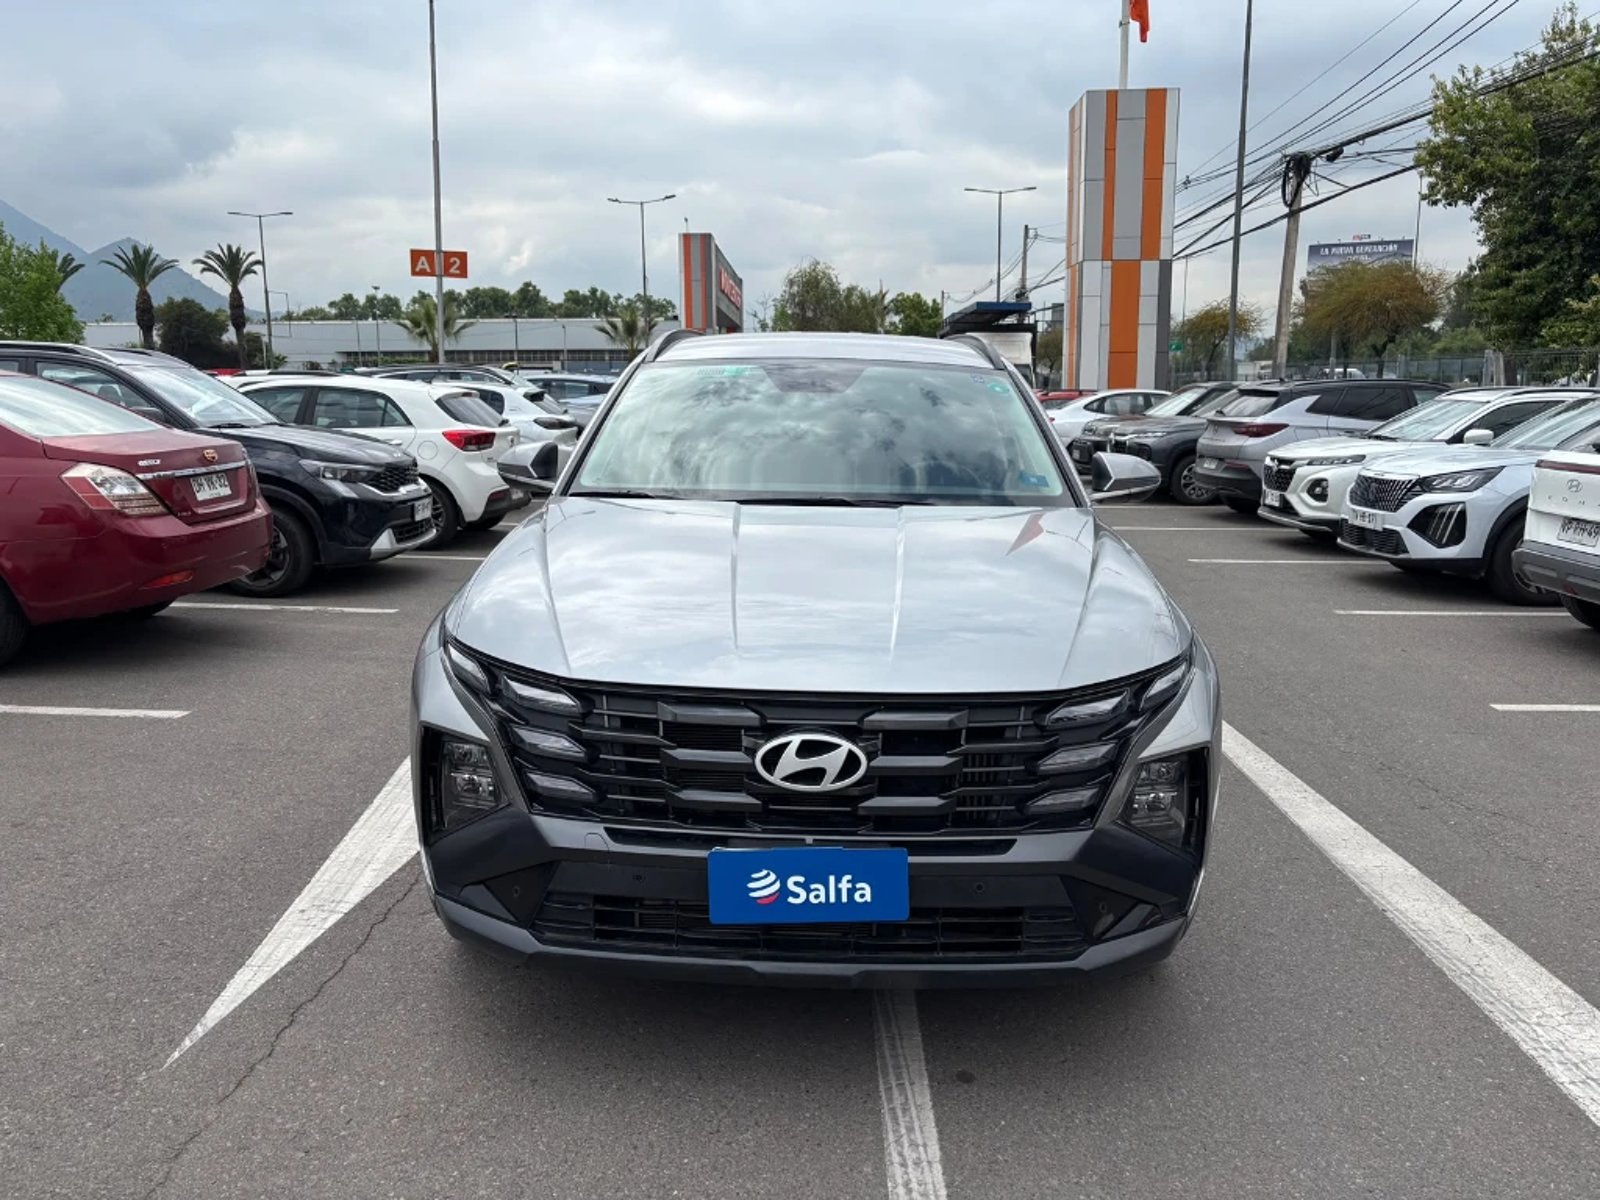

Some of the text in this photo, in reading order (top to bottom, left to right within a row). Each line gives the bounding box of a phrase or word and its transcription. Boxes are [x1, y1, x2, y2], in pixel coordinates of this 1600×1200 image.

[415, 256, 461, 274] A 2
[786, 874, 872, 904] Salfa
